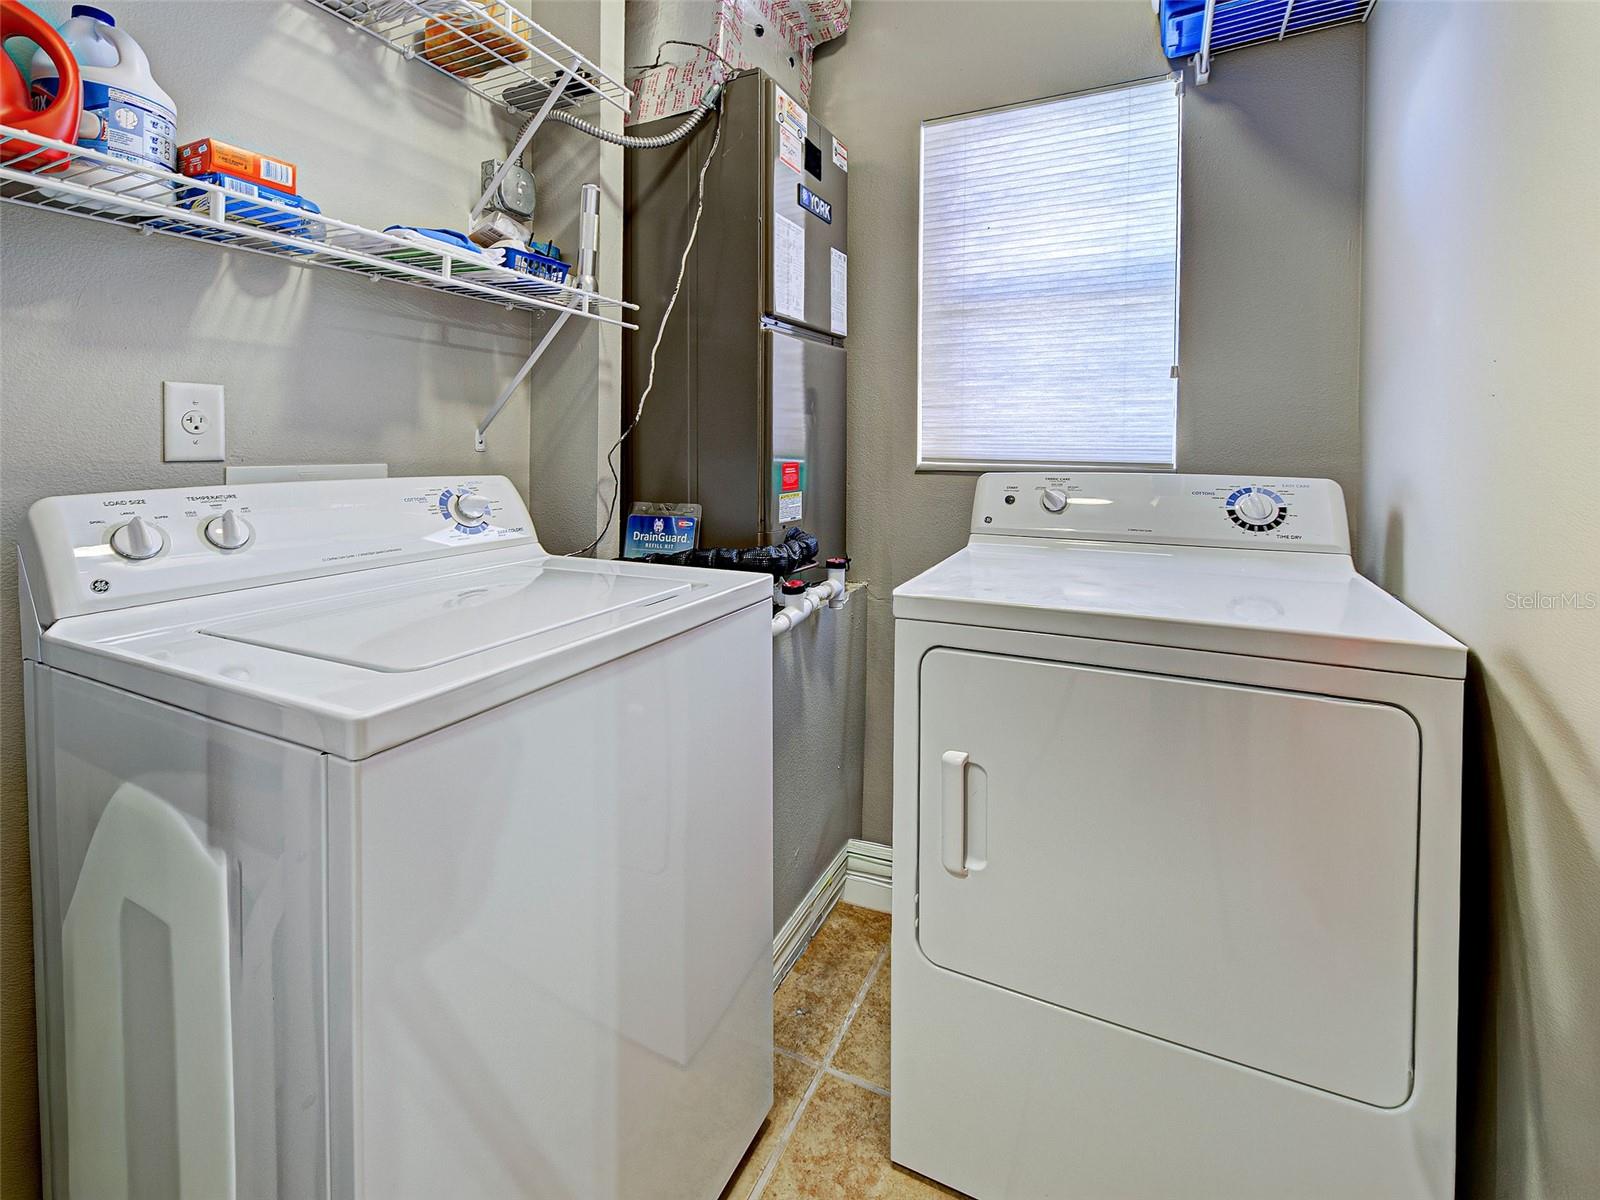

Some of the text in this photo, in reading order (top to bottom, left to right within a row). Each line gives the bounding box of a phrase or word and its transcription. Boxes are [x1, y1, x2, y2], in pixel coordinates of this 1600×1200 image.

[809, 191, 831, 221] YORK
[186, 494, 238, 502] TEMPERATURE
[633, 531, 687, 543] DrainGuard
